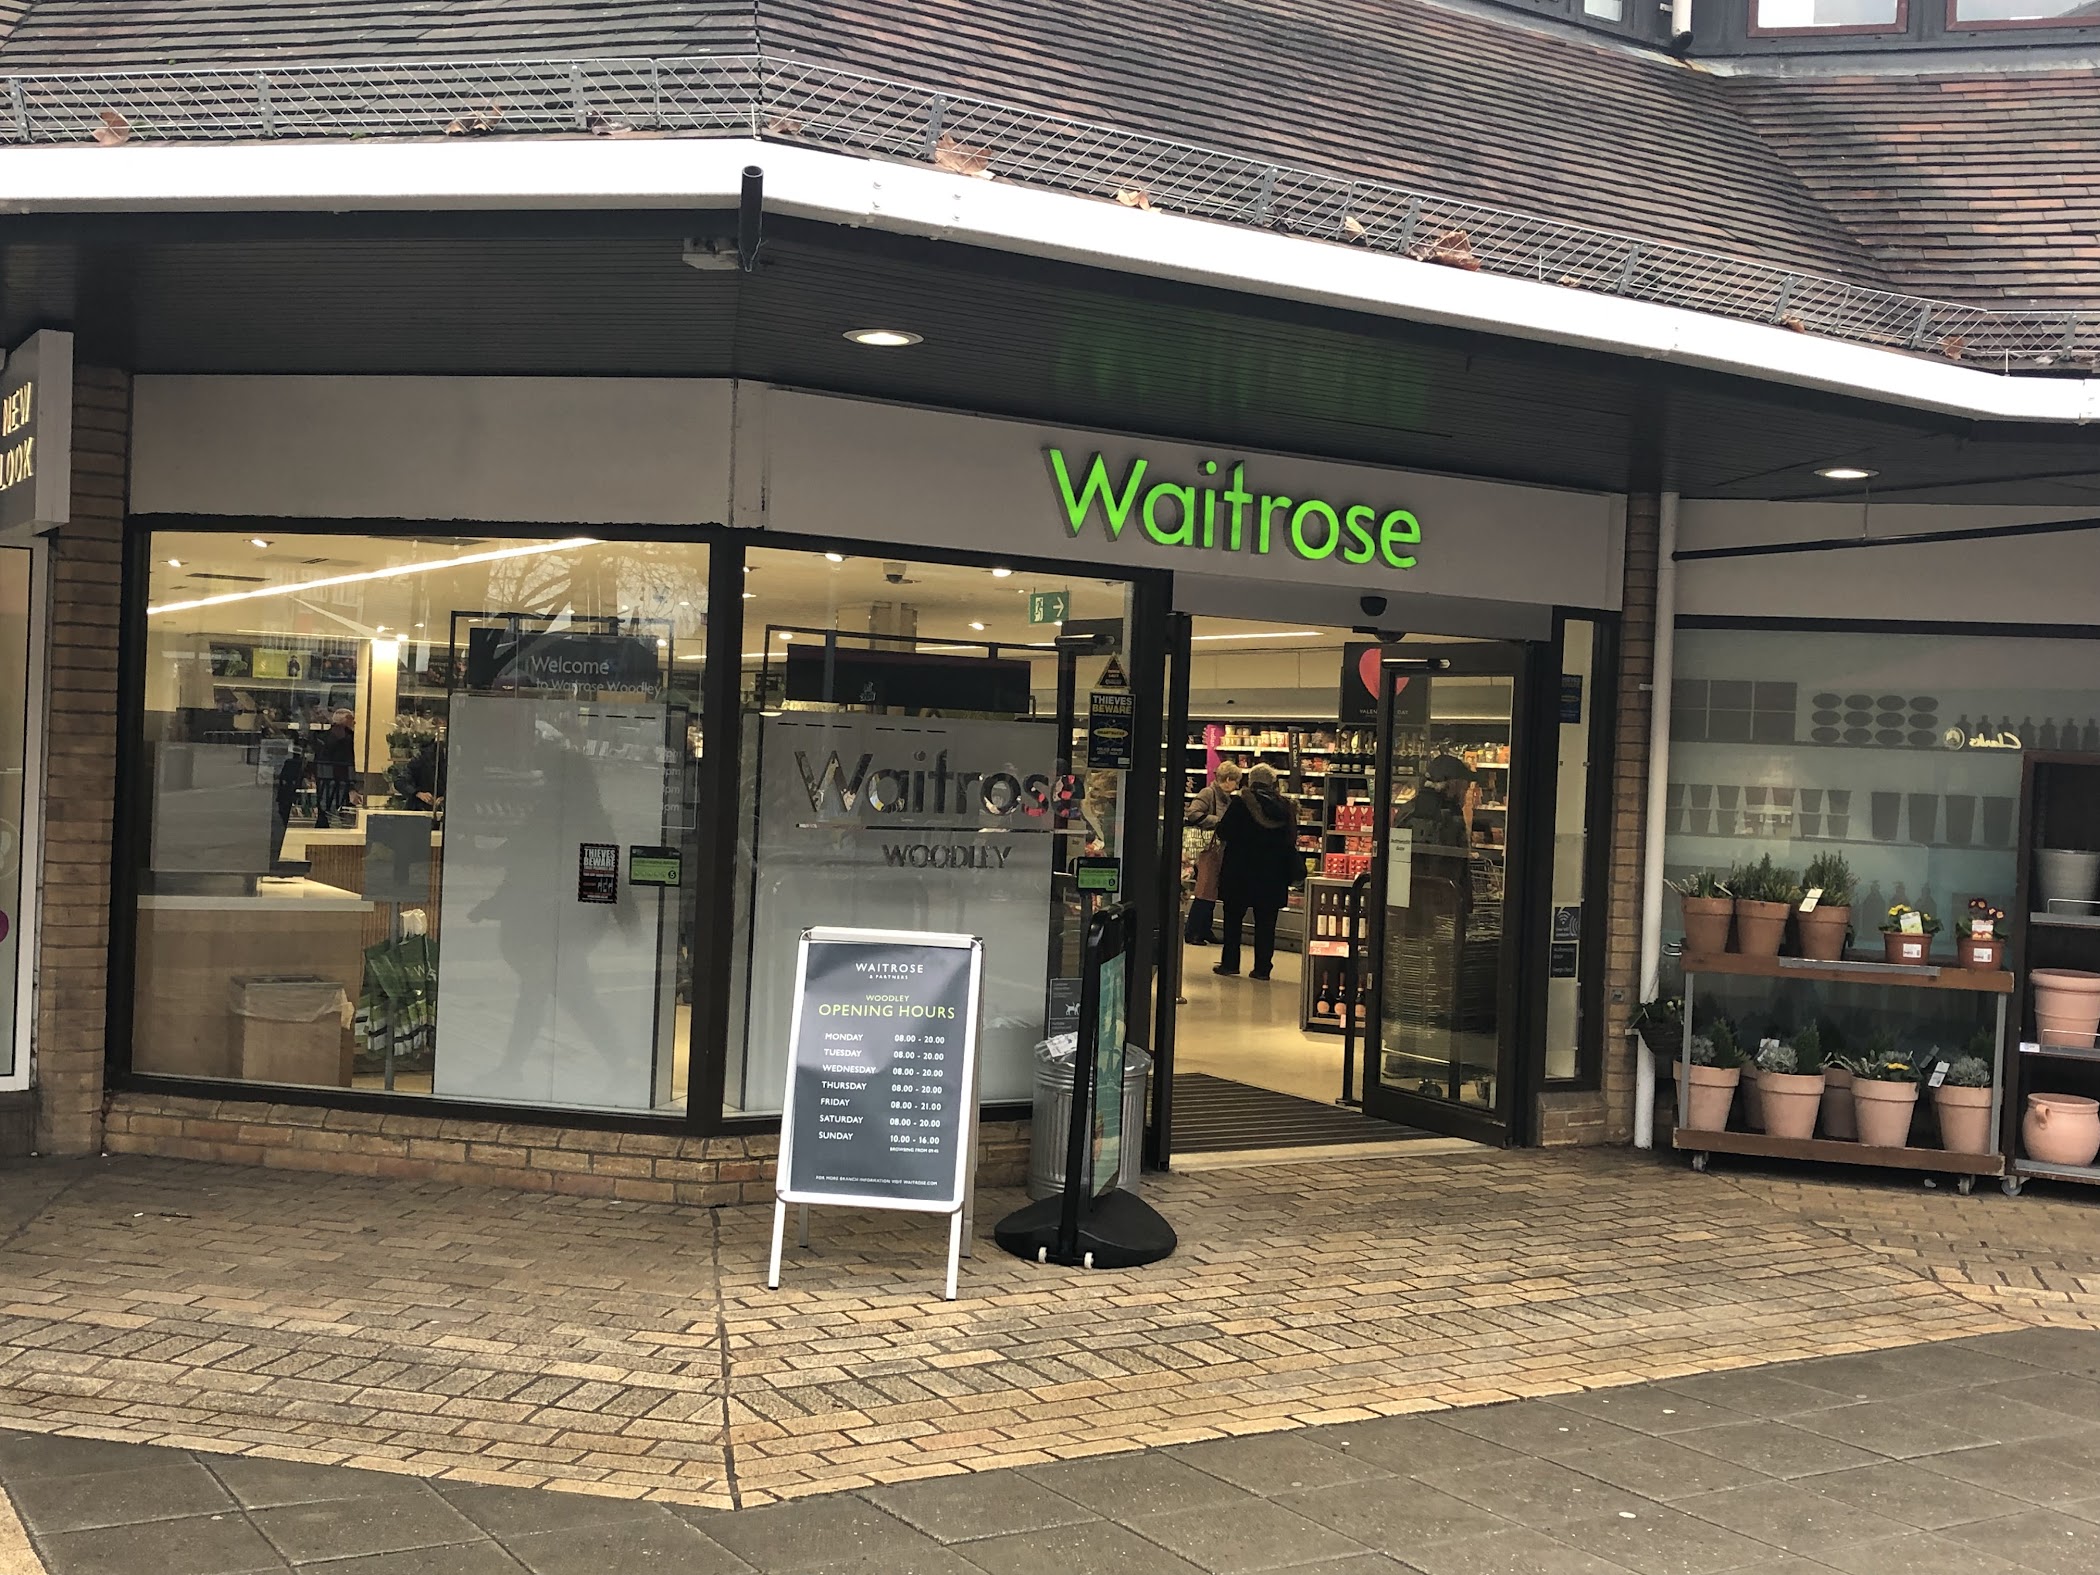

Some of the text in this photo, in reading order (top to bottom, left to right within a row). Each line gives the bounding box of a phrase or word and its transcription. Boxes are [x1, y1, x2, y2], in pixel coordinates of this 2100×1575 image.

[2, 382, 32, 436] NEW
[0, 437, 34, 490] LOOK
[1043, 447, 1422, 569] Waitrose
[530, 655, 610, 675] Welcome
[535, 677, 548, 689] to
[551, 678, 604, 692] Waitrose
[606, 679, 662, 699] Woodley
[1092, 695, 1132, 706] THIEVES
[1092, 704, 1132, 714] BEWARE
[794, 749, 1085, 819] Waitrose
[584, 848, 616, 858] THIEVES
[881, 844, 1012, 869] WOODLEY
[583, 857, 615, 867] BEWARE
[855, 963, 924, 974] WAITROSE
[865, 994, 910, 1002] WOODLEY
[818, 1004, 955, 1020] OPENING HOURS
[825, 1033, 864, 1042] MONDAY
[894, 1034, 916, 1042] 08.00
[924, 1036, 945, 1044] 20.00
[823, 1048, 862, 1057] TUESDAY
[893, 1050, 915, 1059] 08.00
[923, 1052, 944, 1061] 20.00
[822, 1064, 876, 1074] WEDNESDAY
[892, 1067, 914, 1076] 08.00
[922, 1069, 943, 1077] 20.00
[821, 1080, 867, 1090] THURSDAY
[891, 1084, 913, 1093] 08.00
[921, 1086, 943, 1094] 20.00
[820, 1098, 850, 1107] FRIDAY
[890, 1101, 912, 1109] 08.00
[920, 1103, 942, 1111] 21.00
[819, 1114, 864, 1124] SATURDAY
[889, 1118, 911, 1126] 08.00
[919, 1119, 941, 1128] 20.00
[818, 1131, 854, 1140] SUNDAY
[890, 1135, 911, 1143] 10.00
[918, 1136, 940, 1145] 16.00
